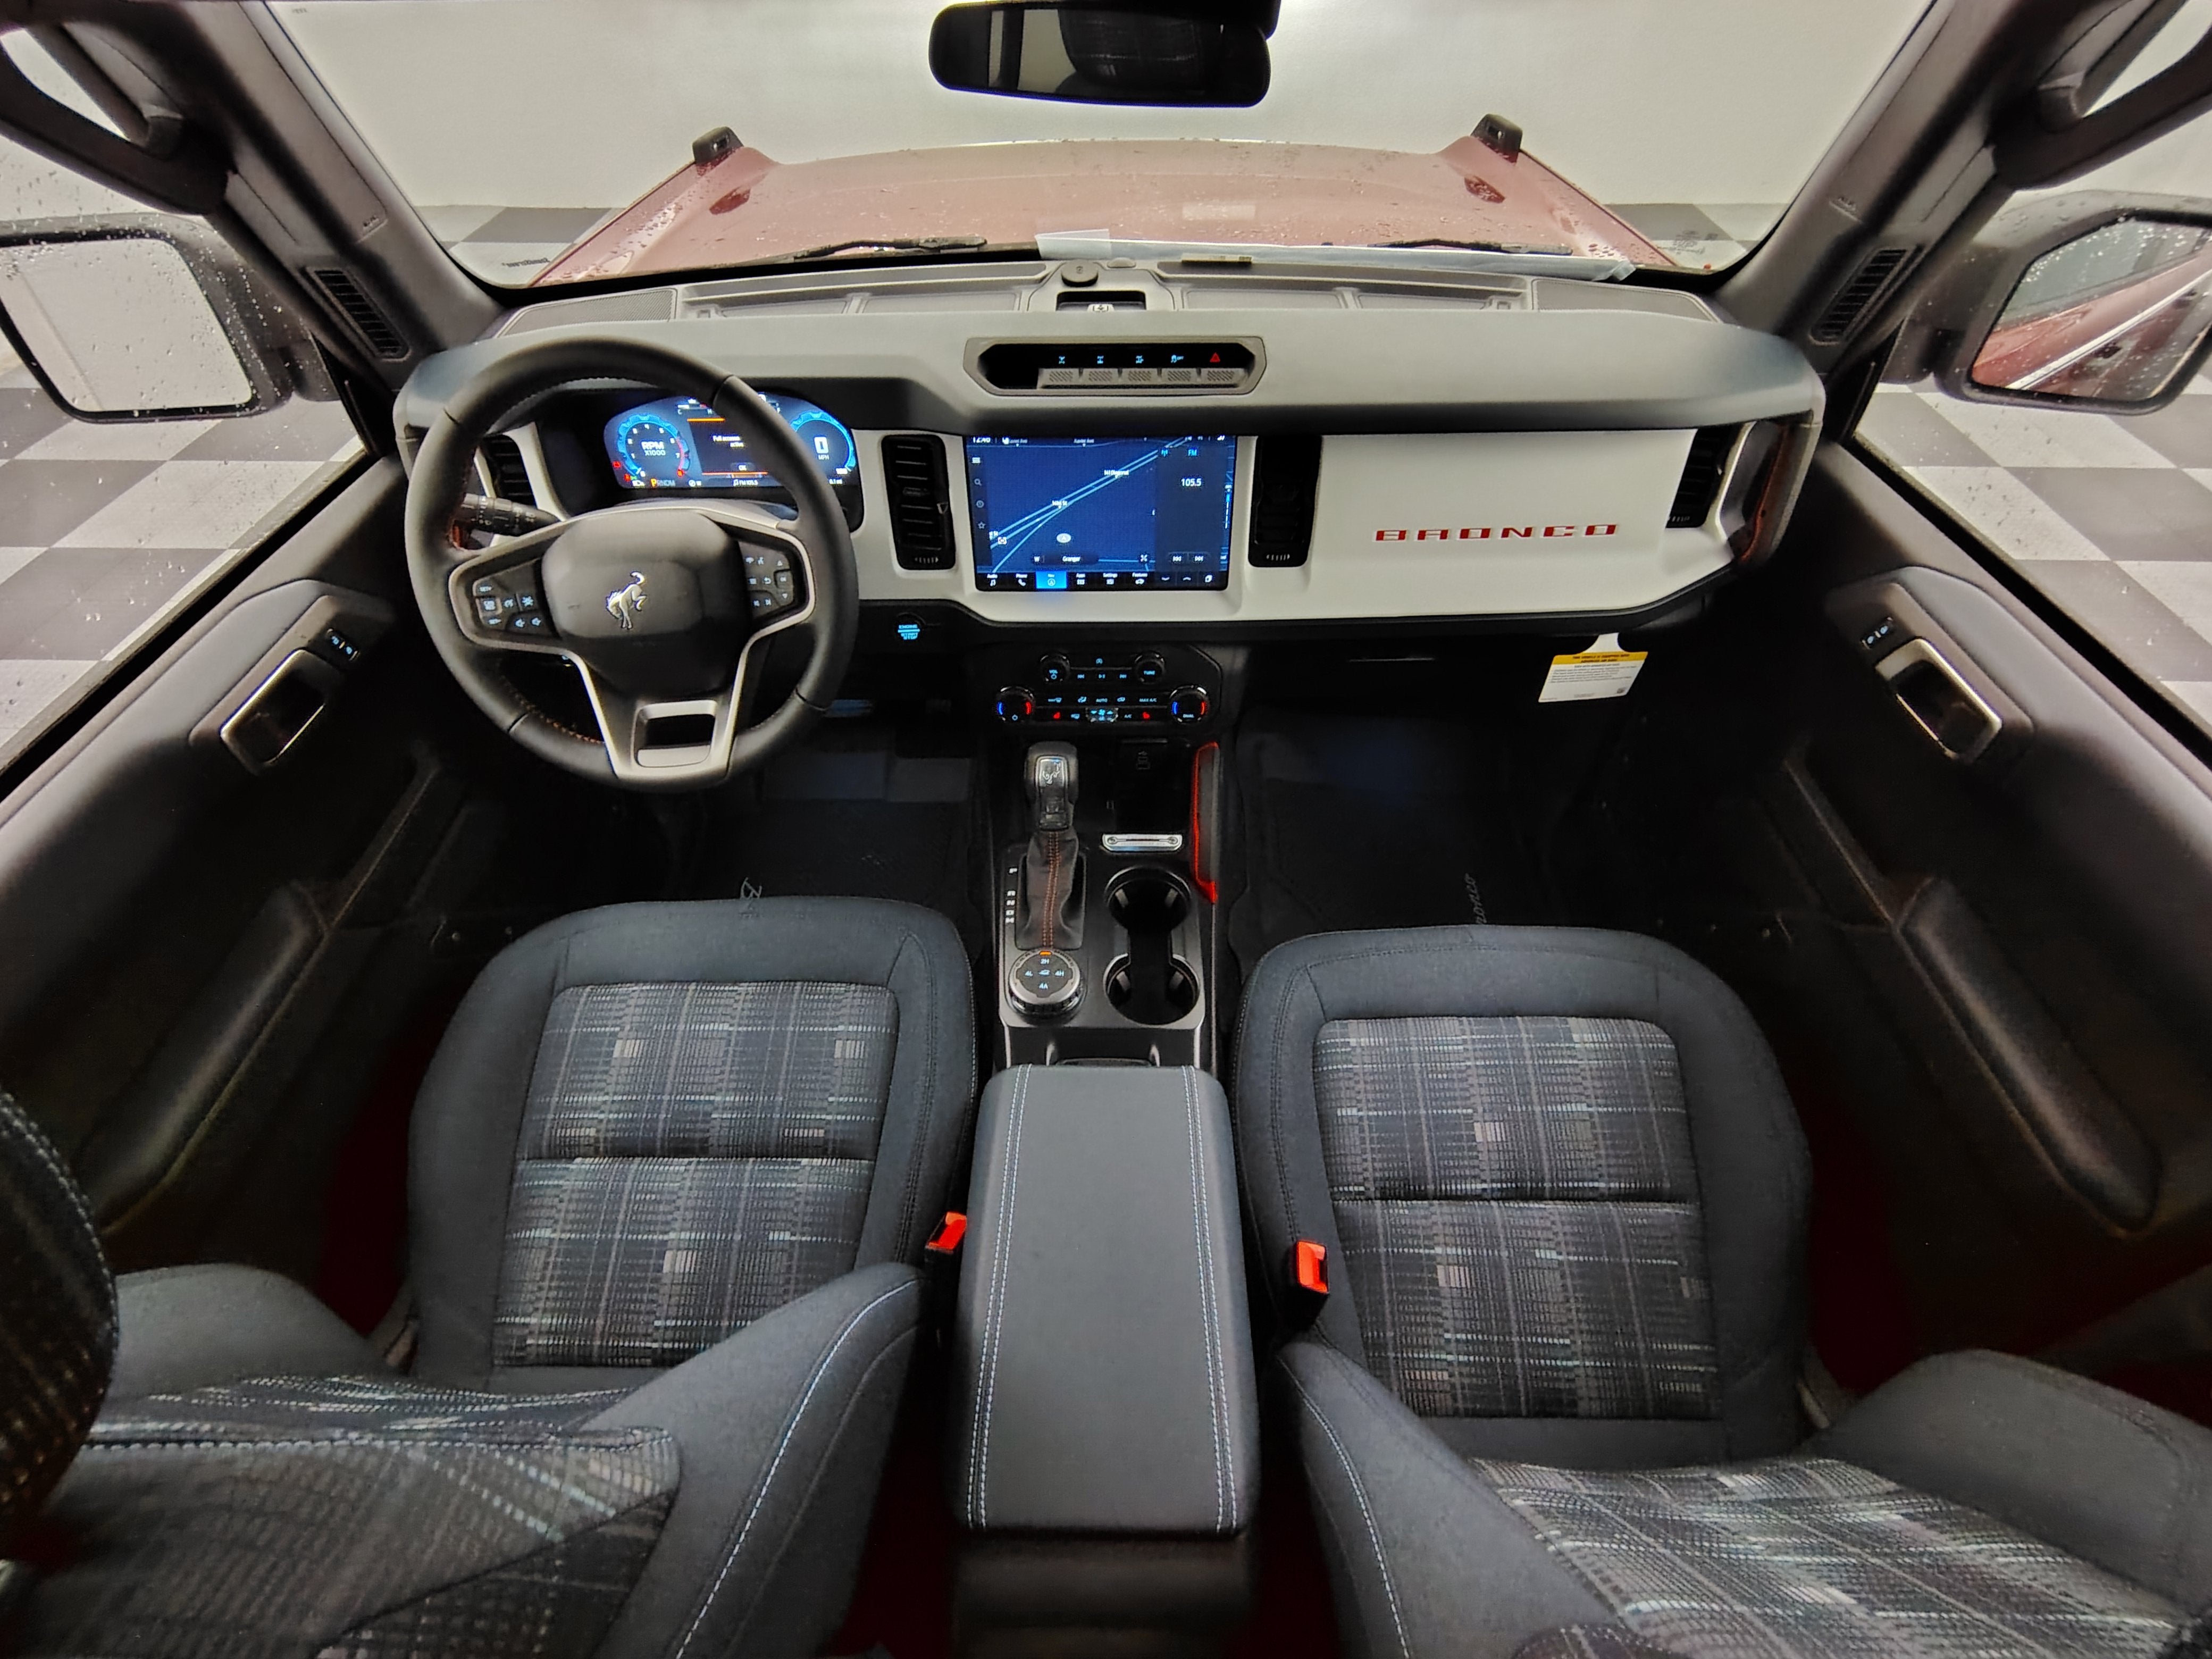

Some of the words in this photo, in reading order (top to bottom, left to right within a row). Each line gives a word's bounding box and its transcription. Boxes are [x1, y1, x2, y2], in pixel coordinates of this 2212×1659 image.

[641, 441, 664, 450] RPM
[814, 437, 828, 454] 0
[1181, 478, 1202, 487] 105.5
[1375, 524, 1617, 541] BRONCO
